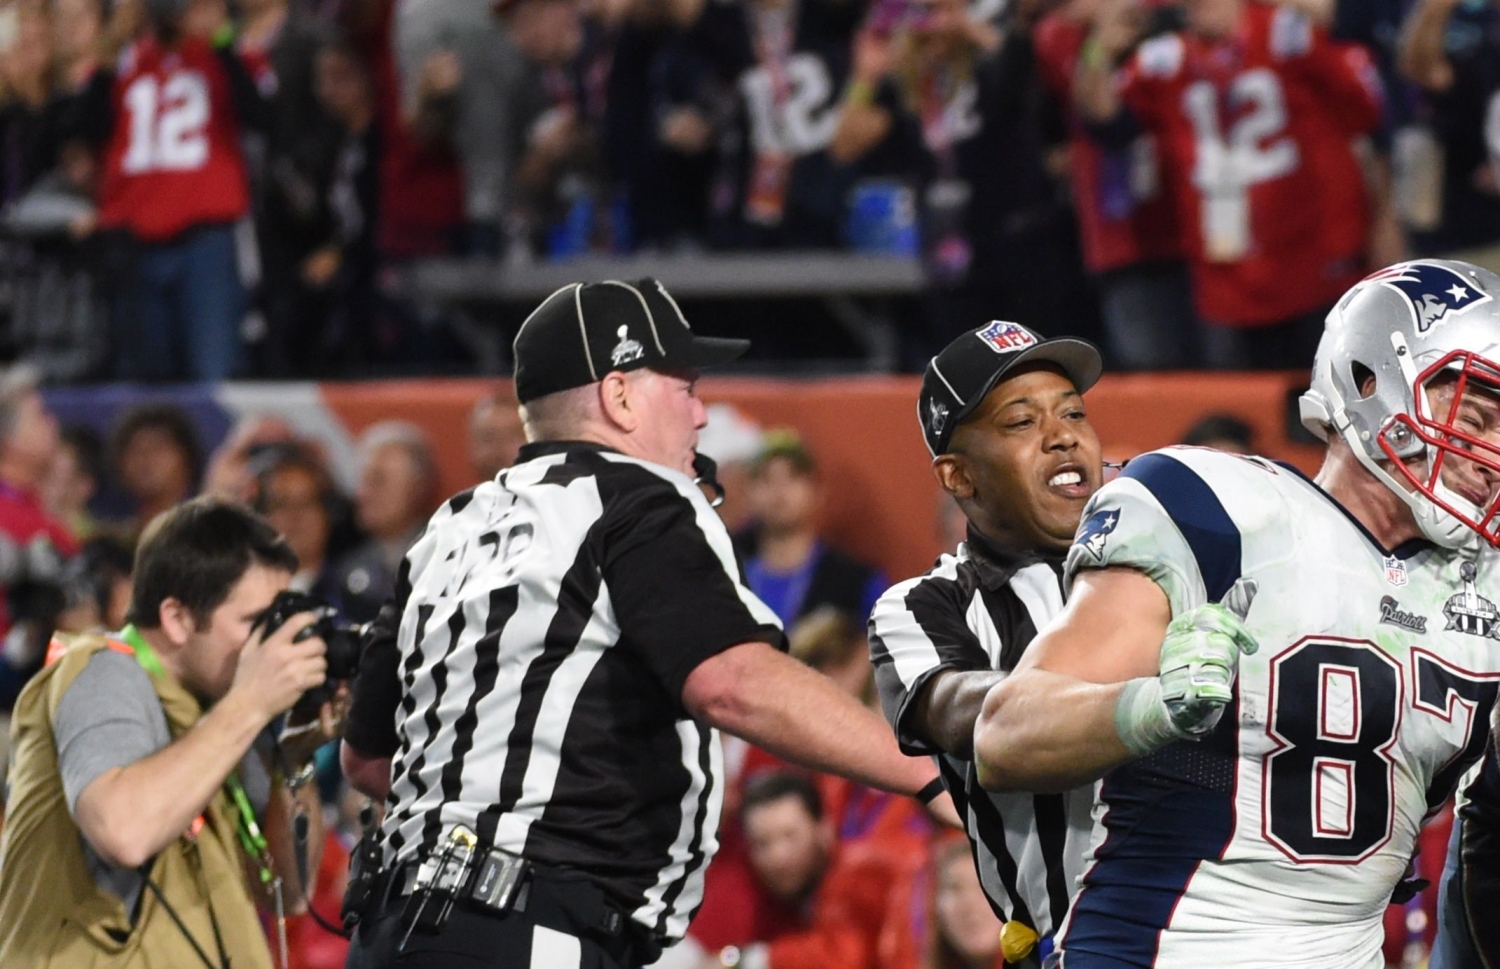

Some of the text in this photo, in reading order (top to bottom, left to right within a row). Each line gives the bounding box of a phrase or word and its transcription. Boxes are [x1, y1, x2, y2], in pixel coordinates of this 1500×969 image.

[122, 70, 211, 176] 12
[738, 53, 843, 158] 12
[1183, 67, 1299, 188] 12
[991, 331, 1033, 350] NFL
[1388, 569, 1406, 584] NFL
[1380, 603, 1427, 634] Patriots
